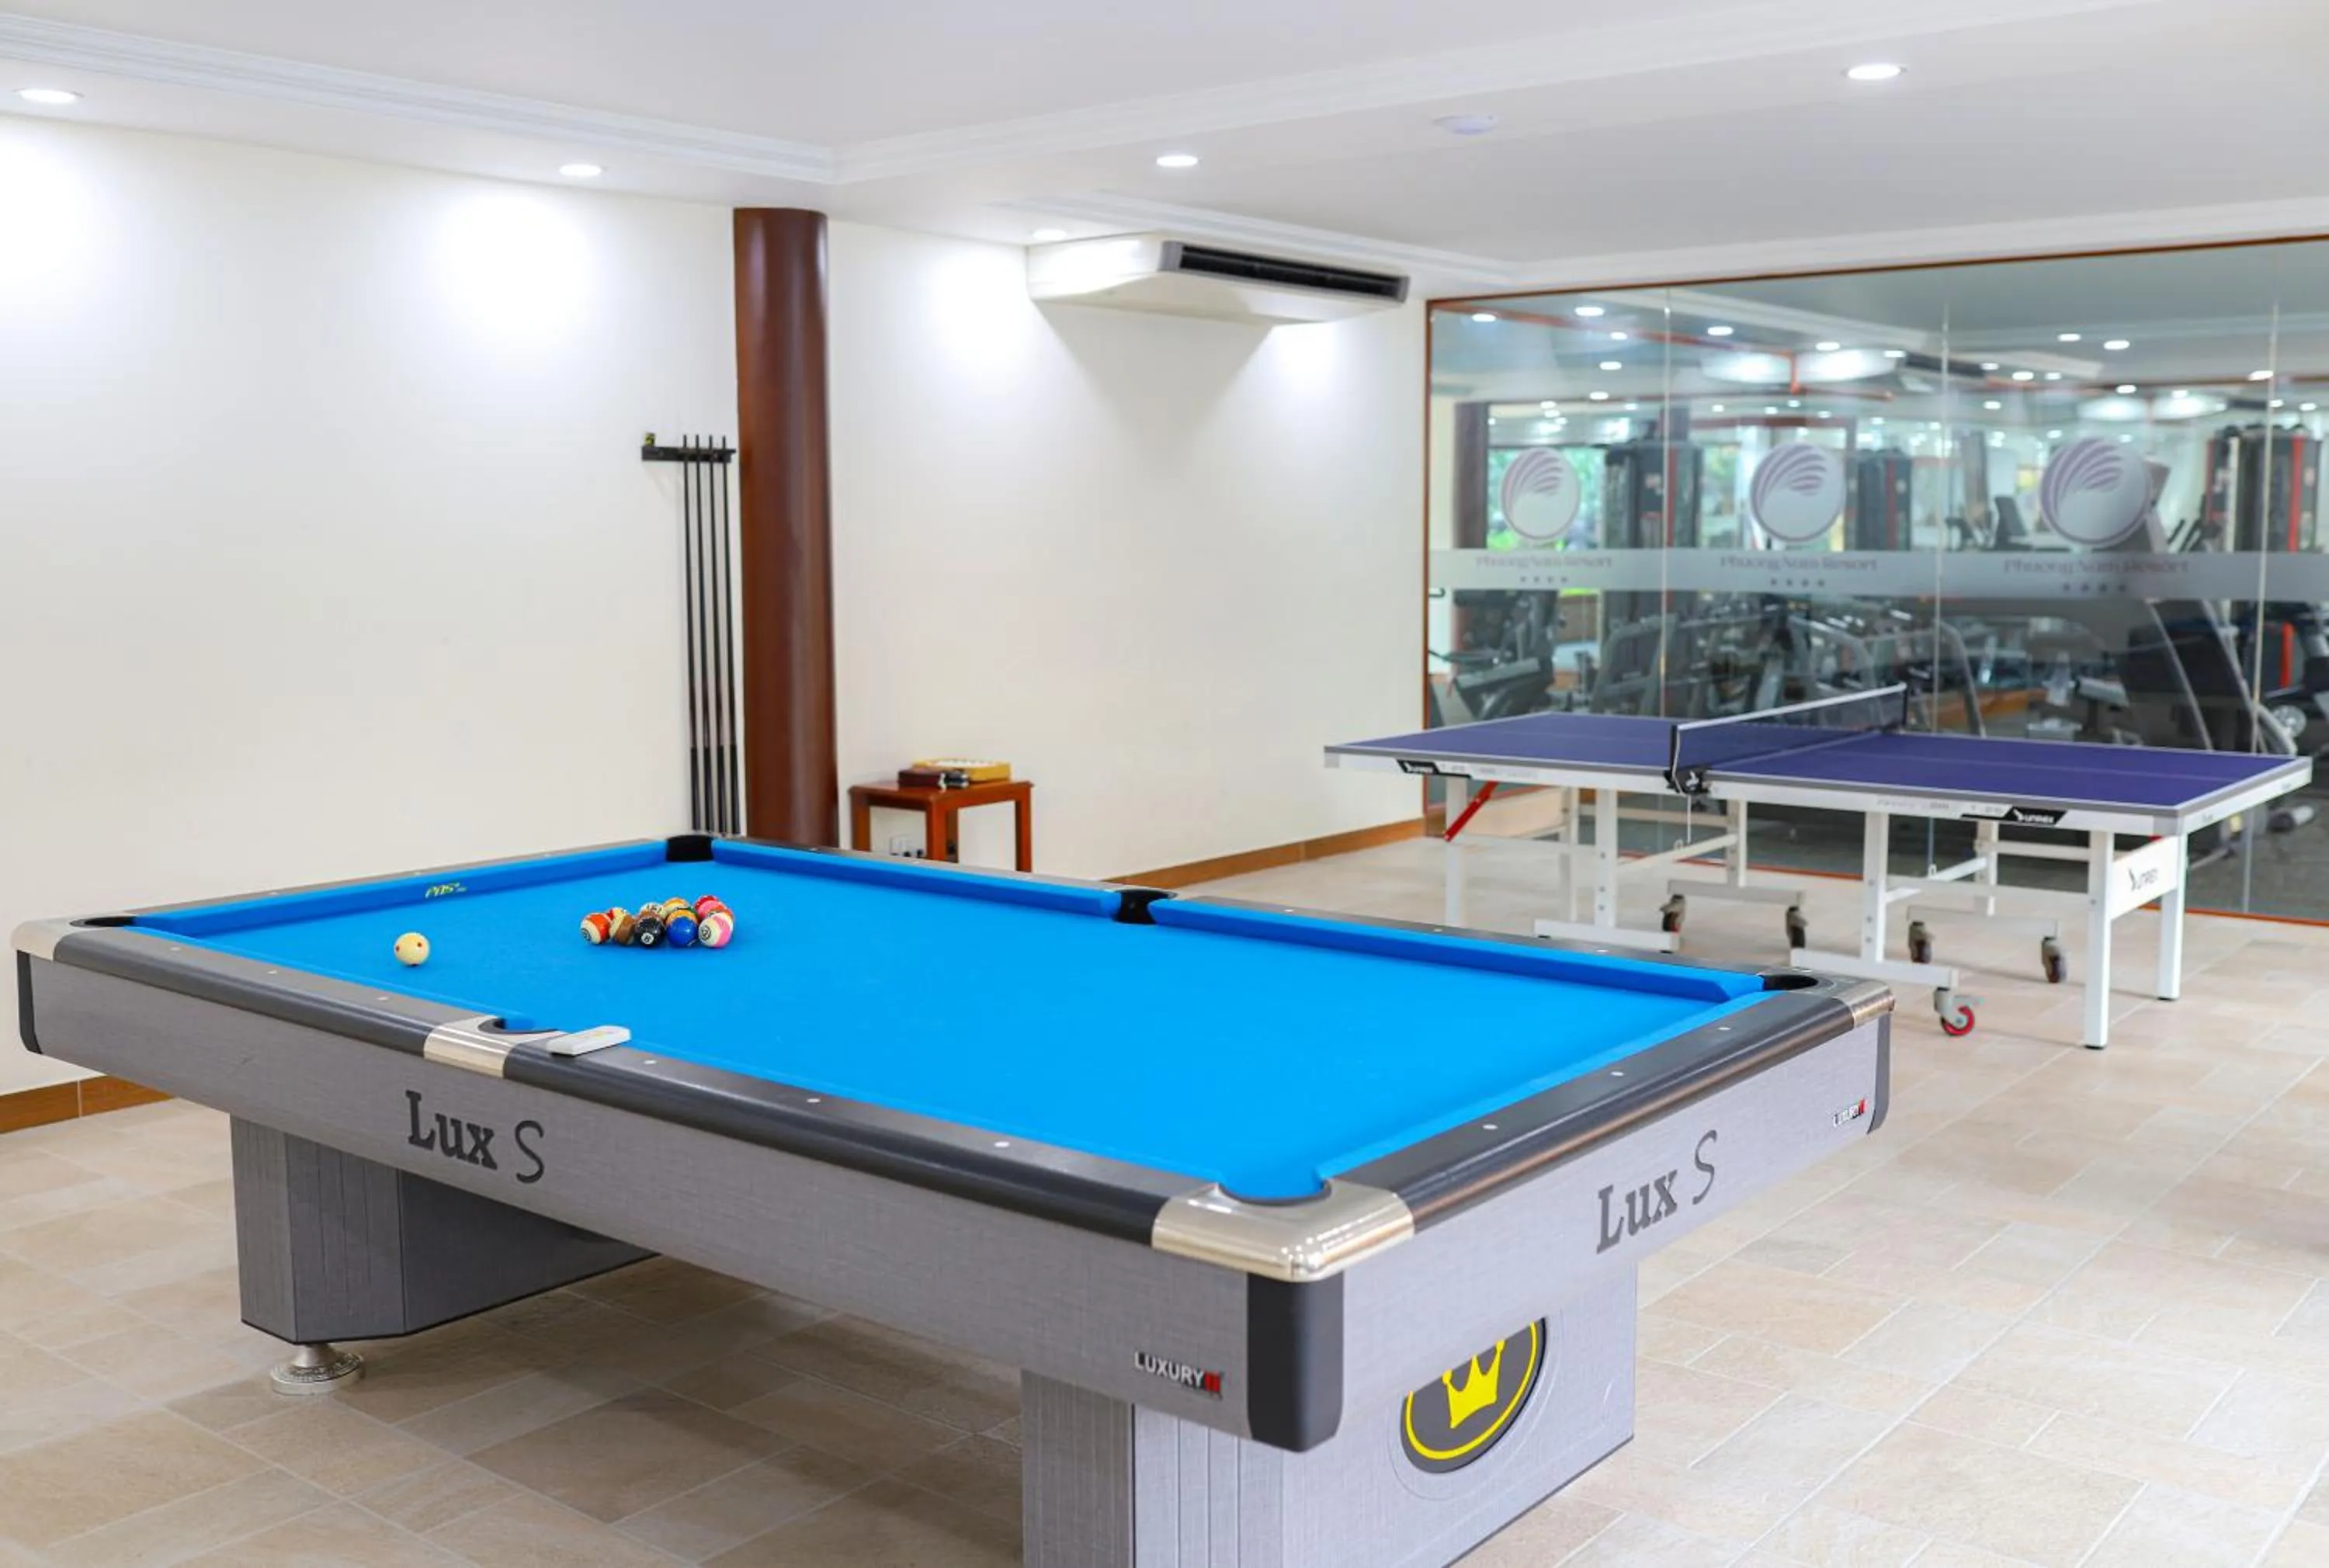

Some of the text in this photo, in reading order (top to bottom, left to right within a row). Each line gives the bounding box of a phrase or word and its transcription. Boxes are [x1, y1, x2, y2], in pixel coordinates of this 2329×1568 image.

[405, 1089, 545, 1183] Lux S
[1596, 1129, 1718, 1254] Lux S
